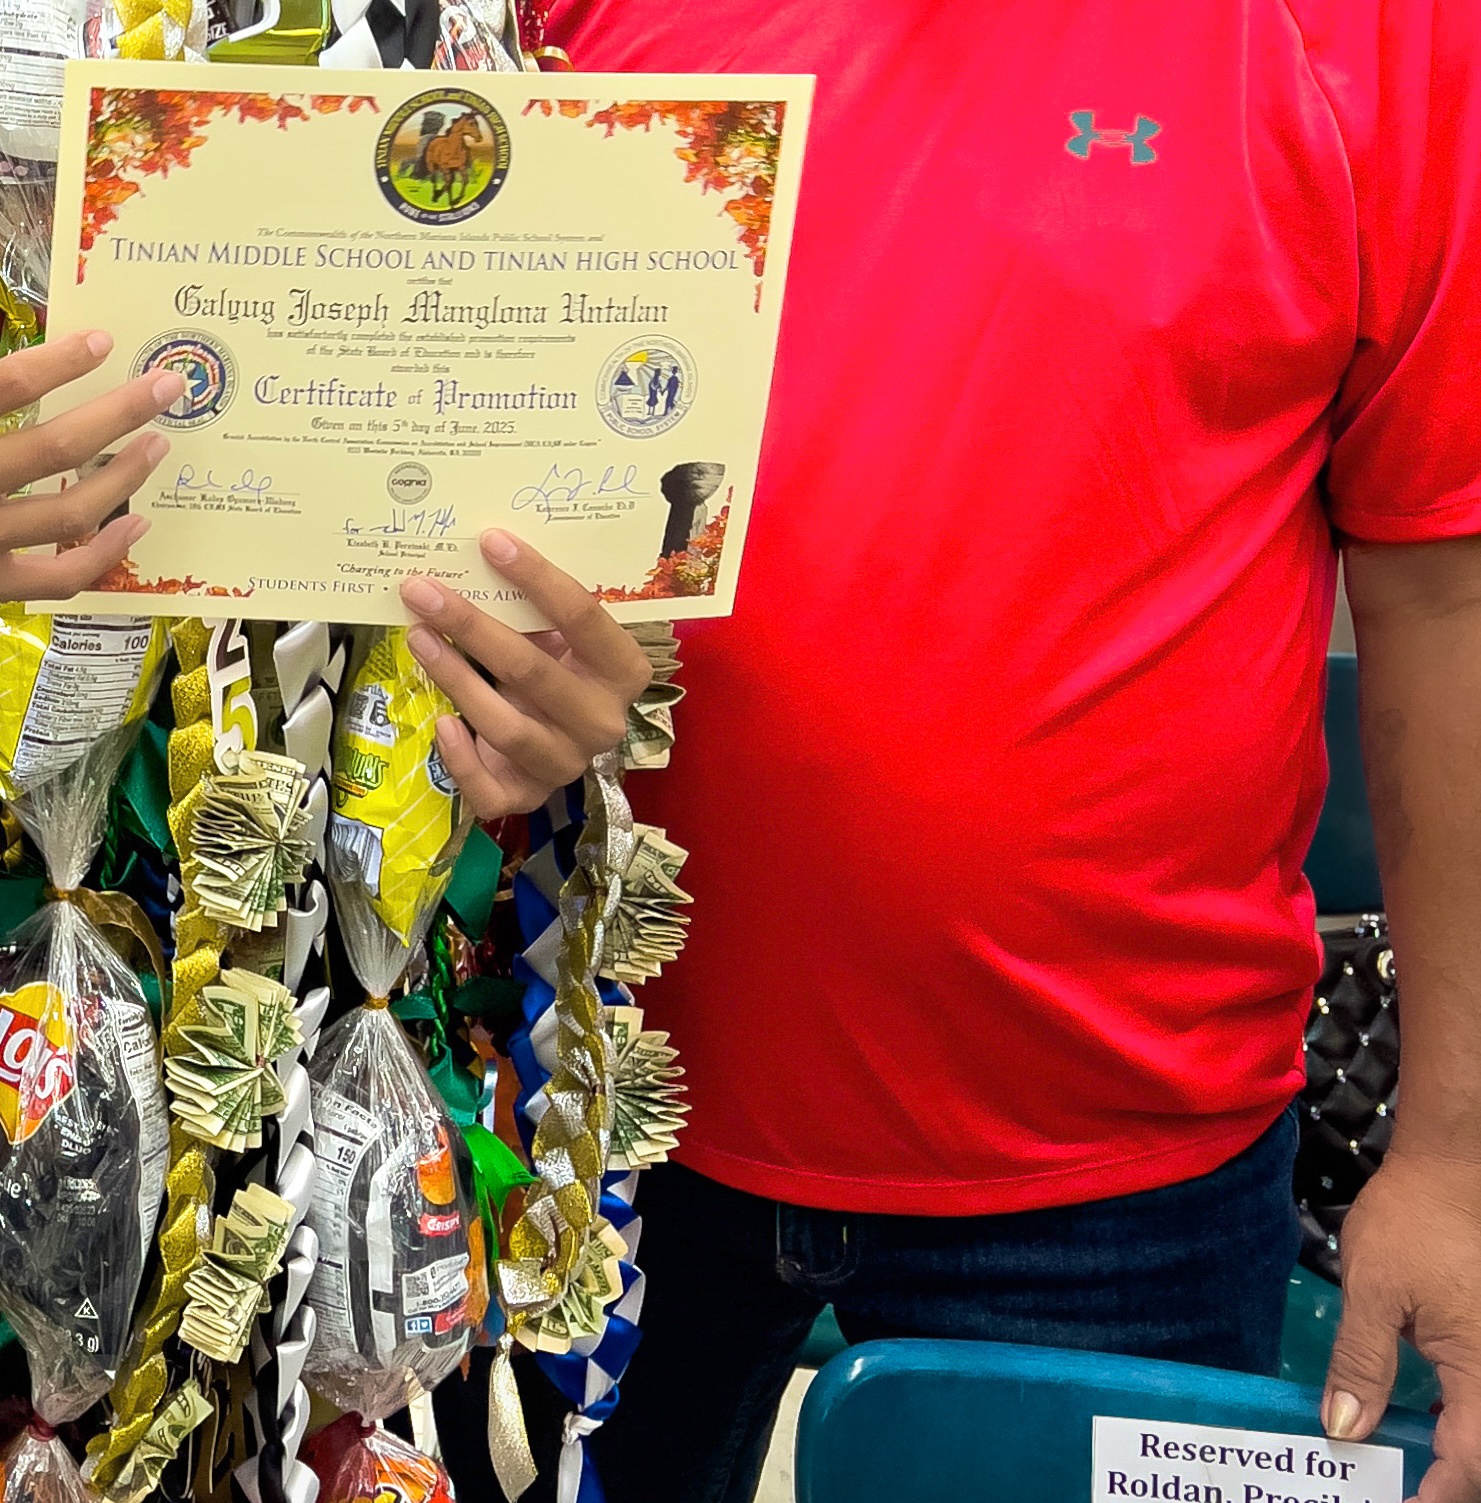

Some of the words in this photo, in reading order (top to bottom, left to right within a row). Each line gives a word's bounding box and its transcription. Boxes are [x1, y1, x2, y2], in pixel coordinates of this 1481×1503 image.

[110, 237, 201, 264] TINIAN
[207, 241, 307, 267] MIDDLE
[314, 243, 416, 270] SCHOOL
[420, 249, 476, 271] AND
[483, 250, 569, 272] TINIAN
[575, 250, 639, 272] HIGH
[646, 249, 740, 271] SCHOOL
[286, 287, 390, 329] Joseph
[400, 289, 549, 330] Manglona
[558, 291, 669, 324] Untalan
[254, 375, 398, 408] Certificate
[407, 389, 424, 405] of
[432, 379, 578, 416] Promotion
[367, 419, 388, 434] this
[247, 576, 328, 593] STUDENTS
[333, 580, 376, 594] FIRST
[51, 635, 102, 651] Calories
[124, 635, 149, 651] 100
[337, 1146, 357, 1165] 150
[427, 1215, 460, 1232] CRISPY
[1140, 1432, 1296, 1474] Reserved
[1305, 1450, 1356, 1481] for
